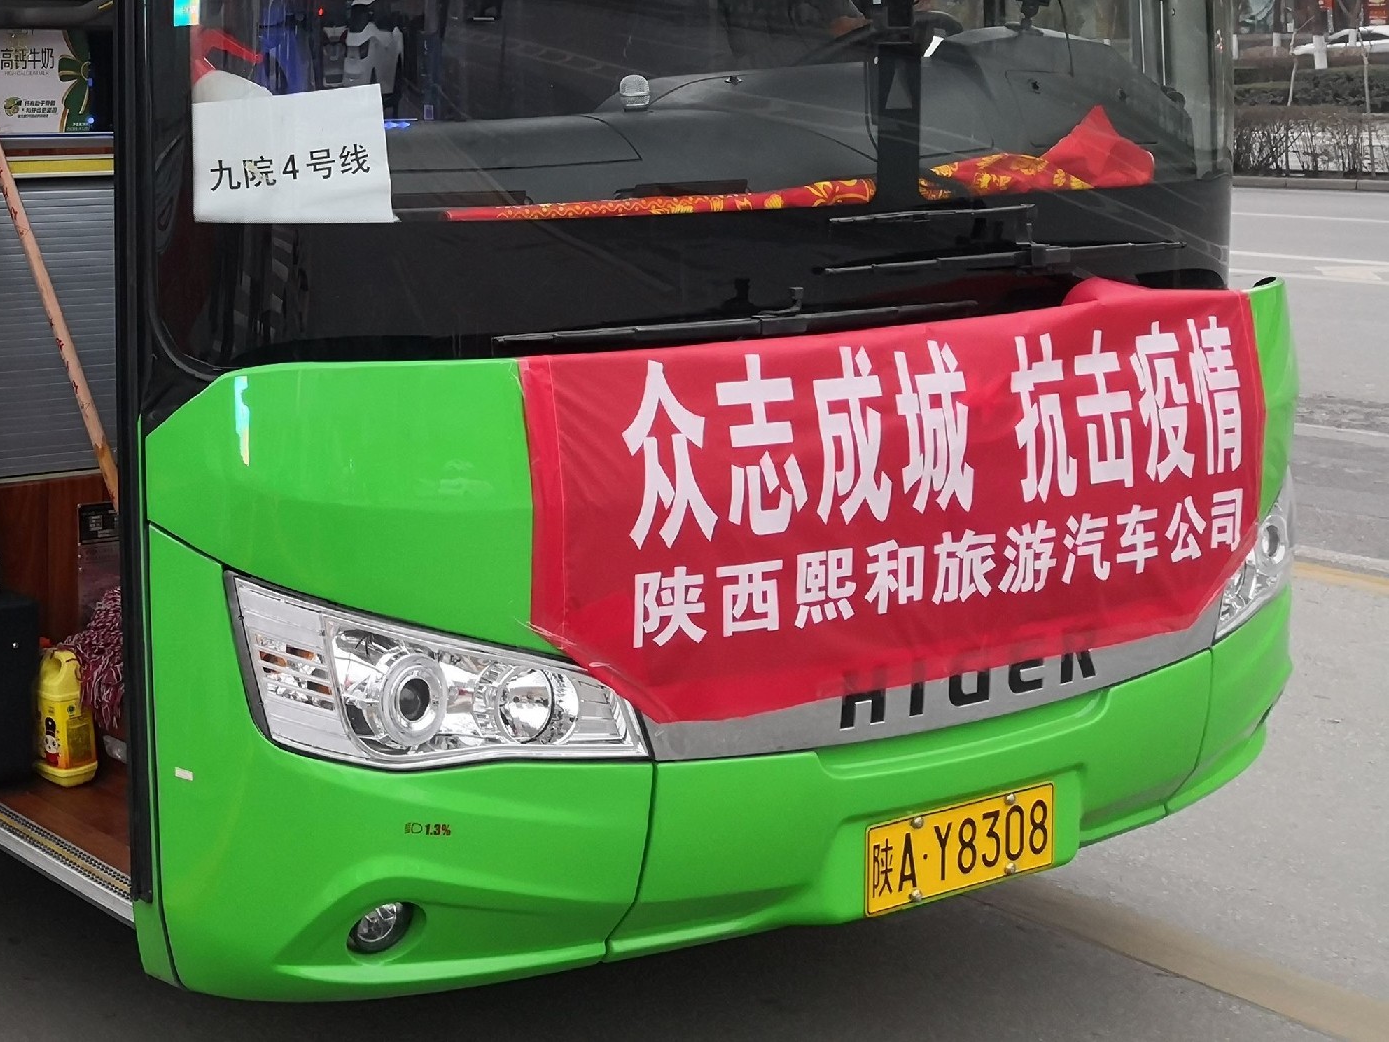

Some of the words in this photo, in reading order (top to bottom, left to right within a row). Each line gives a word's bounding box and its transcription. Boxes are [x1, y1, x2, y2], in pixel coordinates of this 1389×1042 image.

[0, 47, 55, 70] 高钙牛奶
[210, 143, 371, 192] 九院4号线
[621, 339, 974, 550] 众志成城
[1011, 315, 1244, 504] 抗击疫情
[632, 488, 1244, 649] 陕西熙和旅游汽车公司
[425, 824, 451, 835] 1.3%
